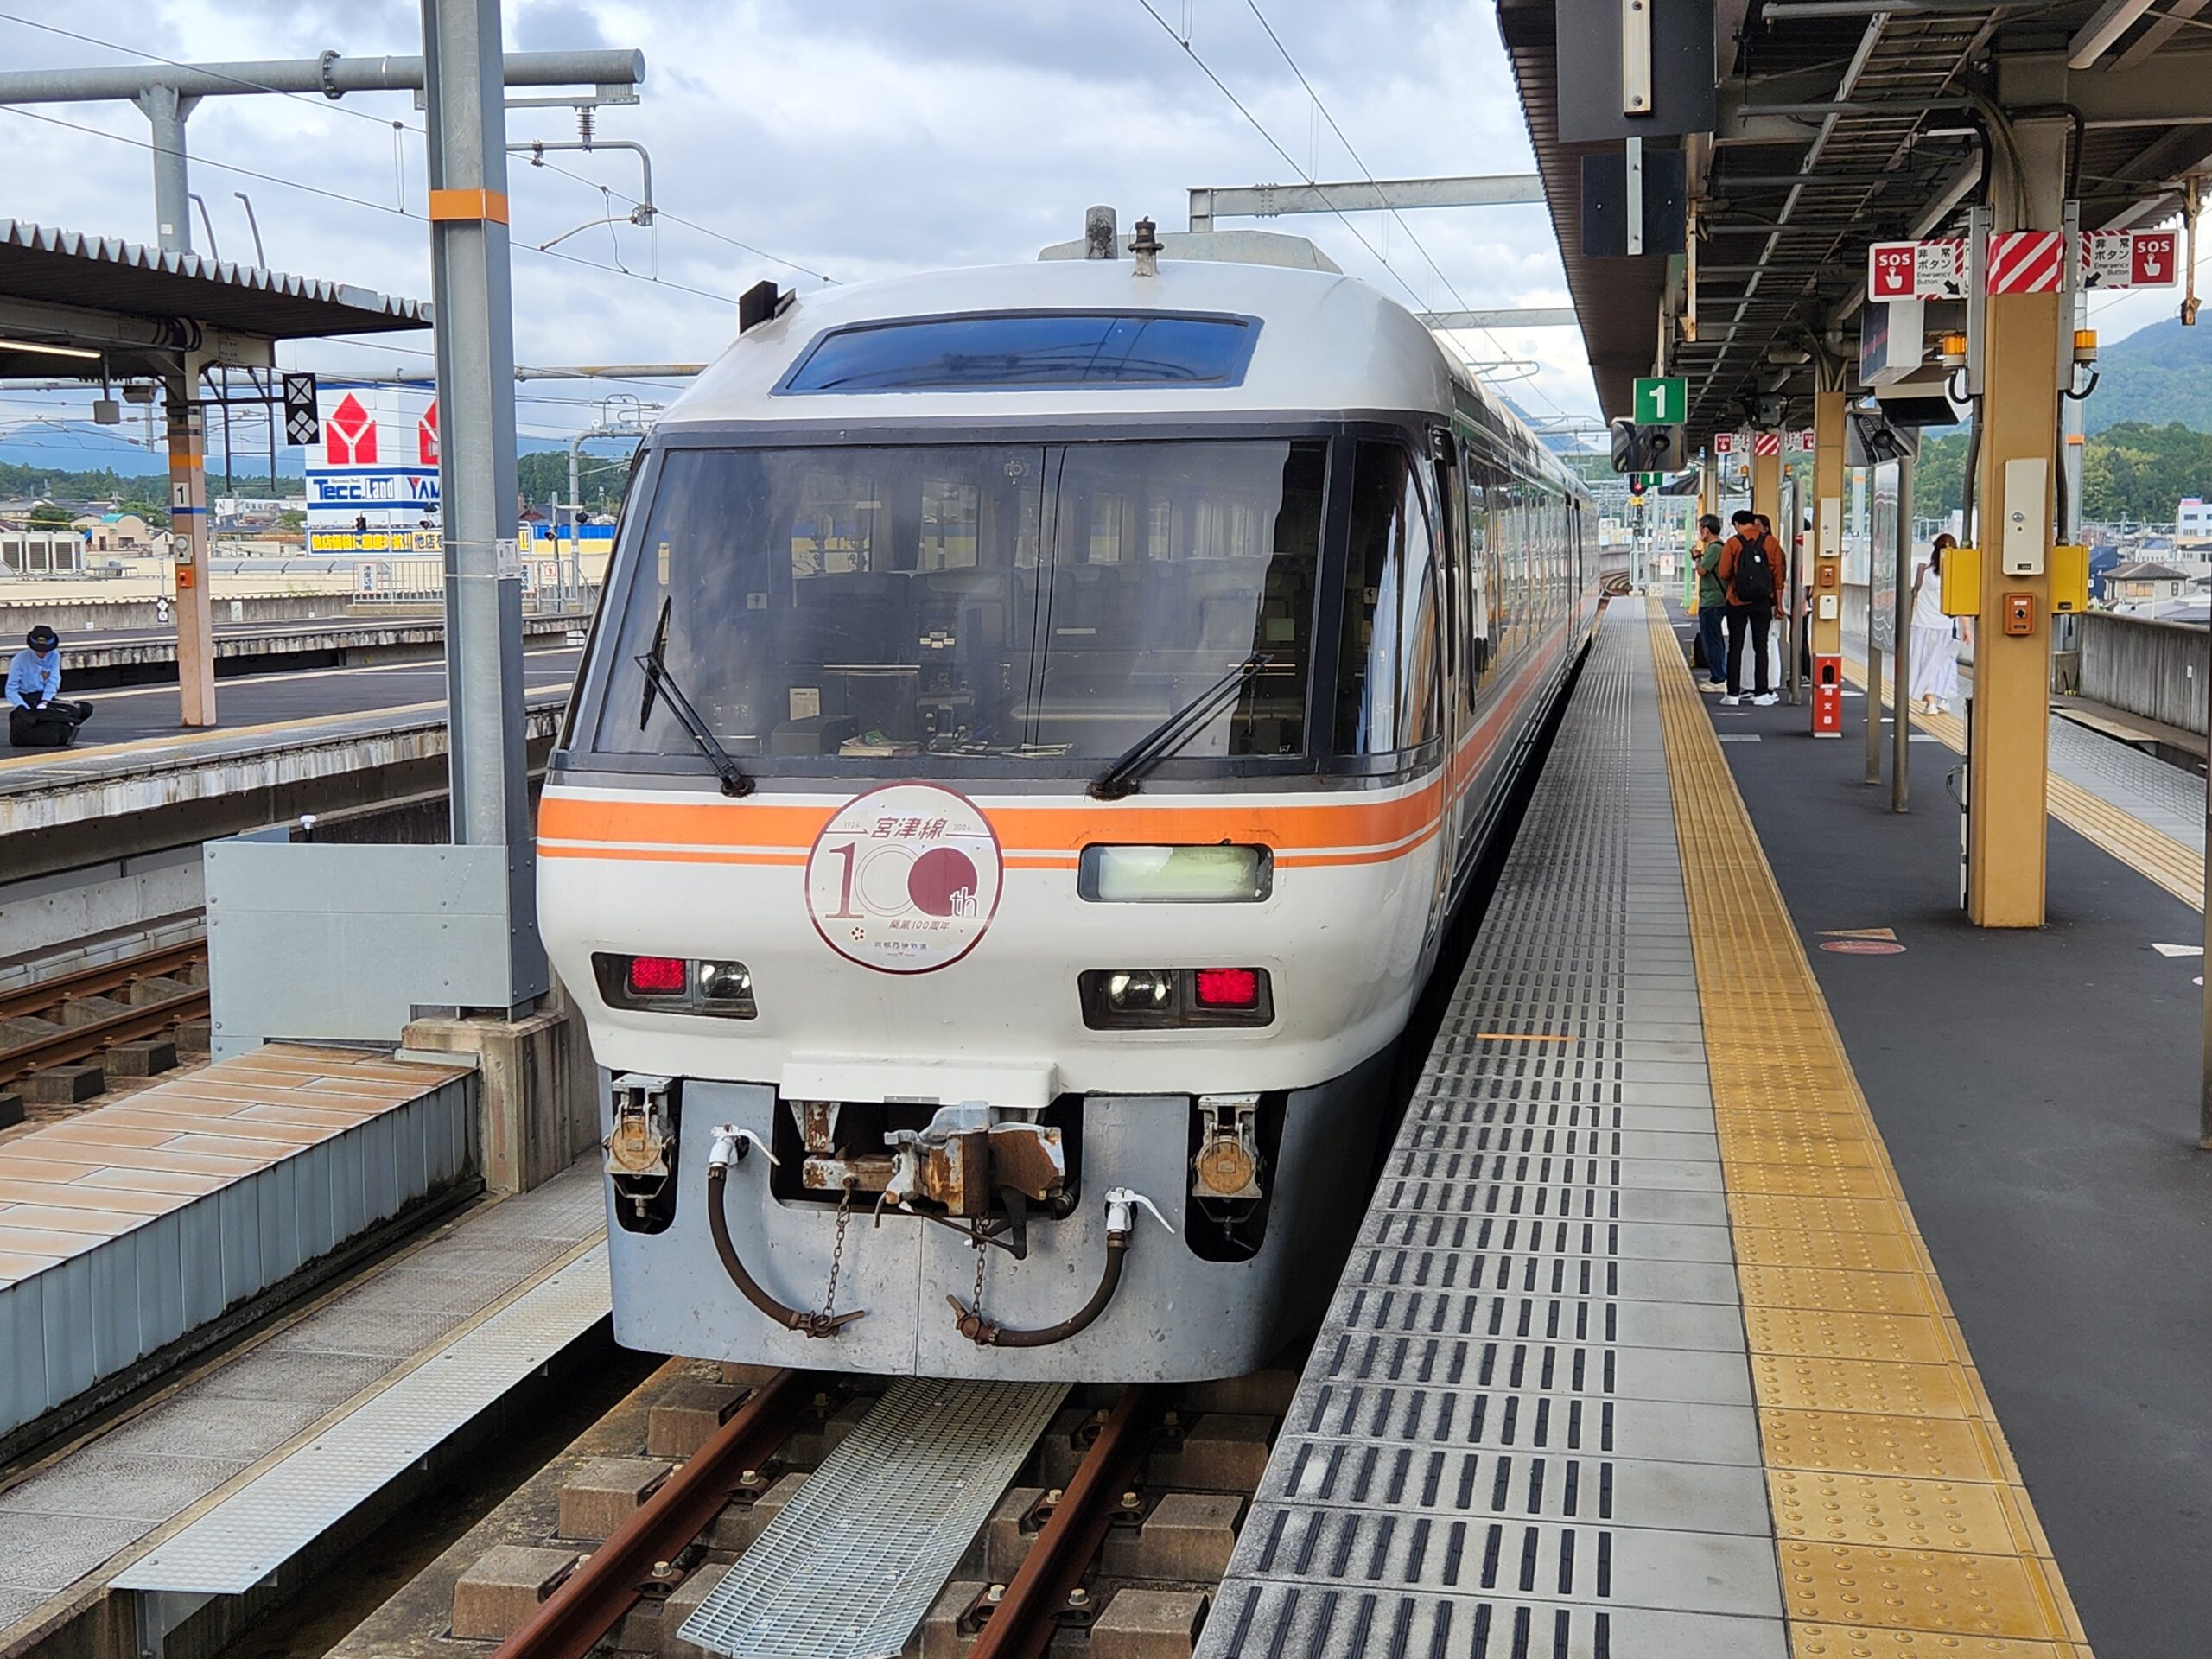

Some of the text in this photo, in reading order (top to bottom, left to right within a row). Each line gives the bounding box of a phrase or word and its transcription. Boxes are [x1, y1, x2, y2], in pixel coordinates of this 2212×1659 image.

[2138, 240, 2170, 253] SOS
[1879, 254, 1910, 266] SOS
[2094, 251, 2129, 261] ボタン
[1917, 260, 1951, 270] ボタン
[1649, 385, 1666, 418] 1
[176, 486, 185, 504] 1
[871, 817, 949, 839] 宮津線
[888, 918, 950, 931] 開業100周年
